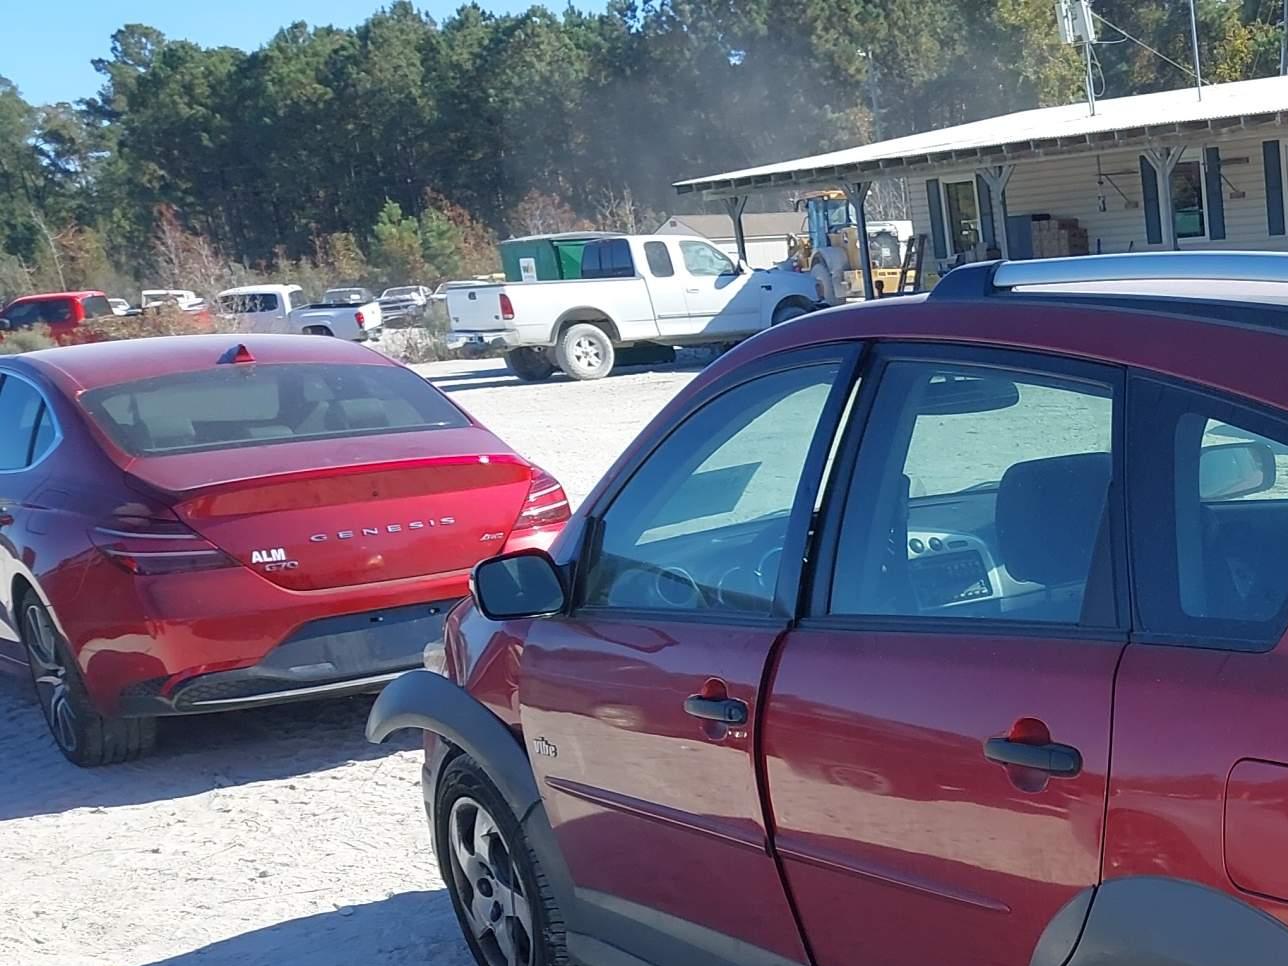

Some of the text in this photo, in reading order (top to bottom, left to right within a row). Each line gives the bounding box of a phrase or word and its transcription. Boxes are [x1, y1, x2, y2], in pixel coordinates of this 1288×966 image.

[309, 516, 456, 542] GENESIS
[251, 548, 286, 564] ALM
[264, 560, 299, 572] G70
